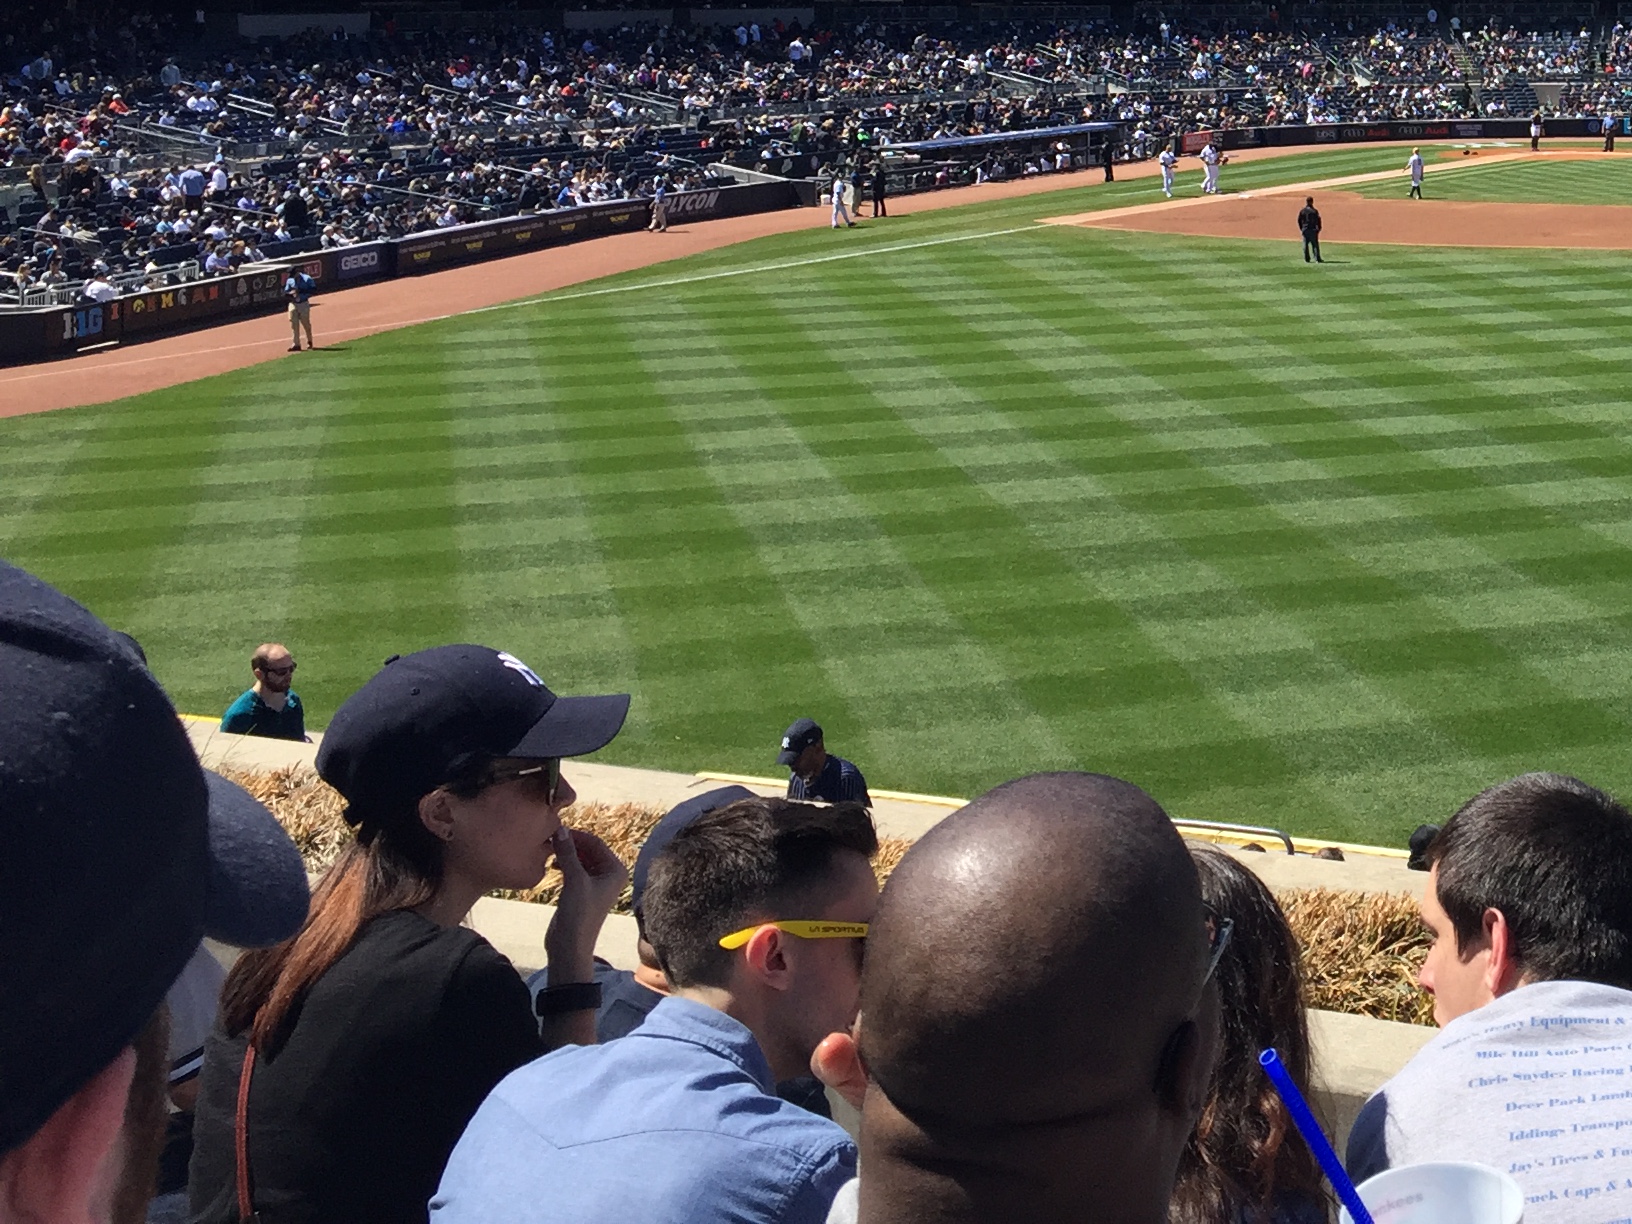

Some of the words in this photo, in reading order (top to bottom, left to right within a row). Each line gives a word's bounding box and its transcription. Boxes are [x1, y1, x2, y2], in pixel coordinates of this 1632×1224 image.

[1367, 128, 1390, 137] Audi
[1425, 126, 1448, 135] Audi
[341, 251, 378, 271] GEICO
[1530, 1015, 1610, 1030] Equipment
[1614, 1017, 1625, 1025] &
[1546, 1048, 1579, 1057] Auto
[1583, 1046, 1622, 1054] Parts
[1468, 1071, 1508, 1089] Chris
[1513, 1066, 1567, 1083] Snyder
[1572, 1066, 1625, 1078] Racing
[1506, 1100, 1544, 1112] Deer
[1549, 1094, 1585, 1108] Park
[1509, 1128, 1565, 1142] Iddings
[1509, 1158, 1544, 1174] Jay's
[1550, 1155, 1588, 1168] Tires
[1593, 1147, 1605, 1159] &
[1564, 1187, 1601, 1199] Caps
[1606, 1181, 1618, 1191] &
